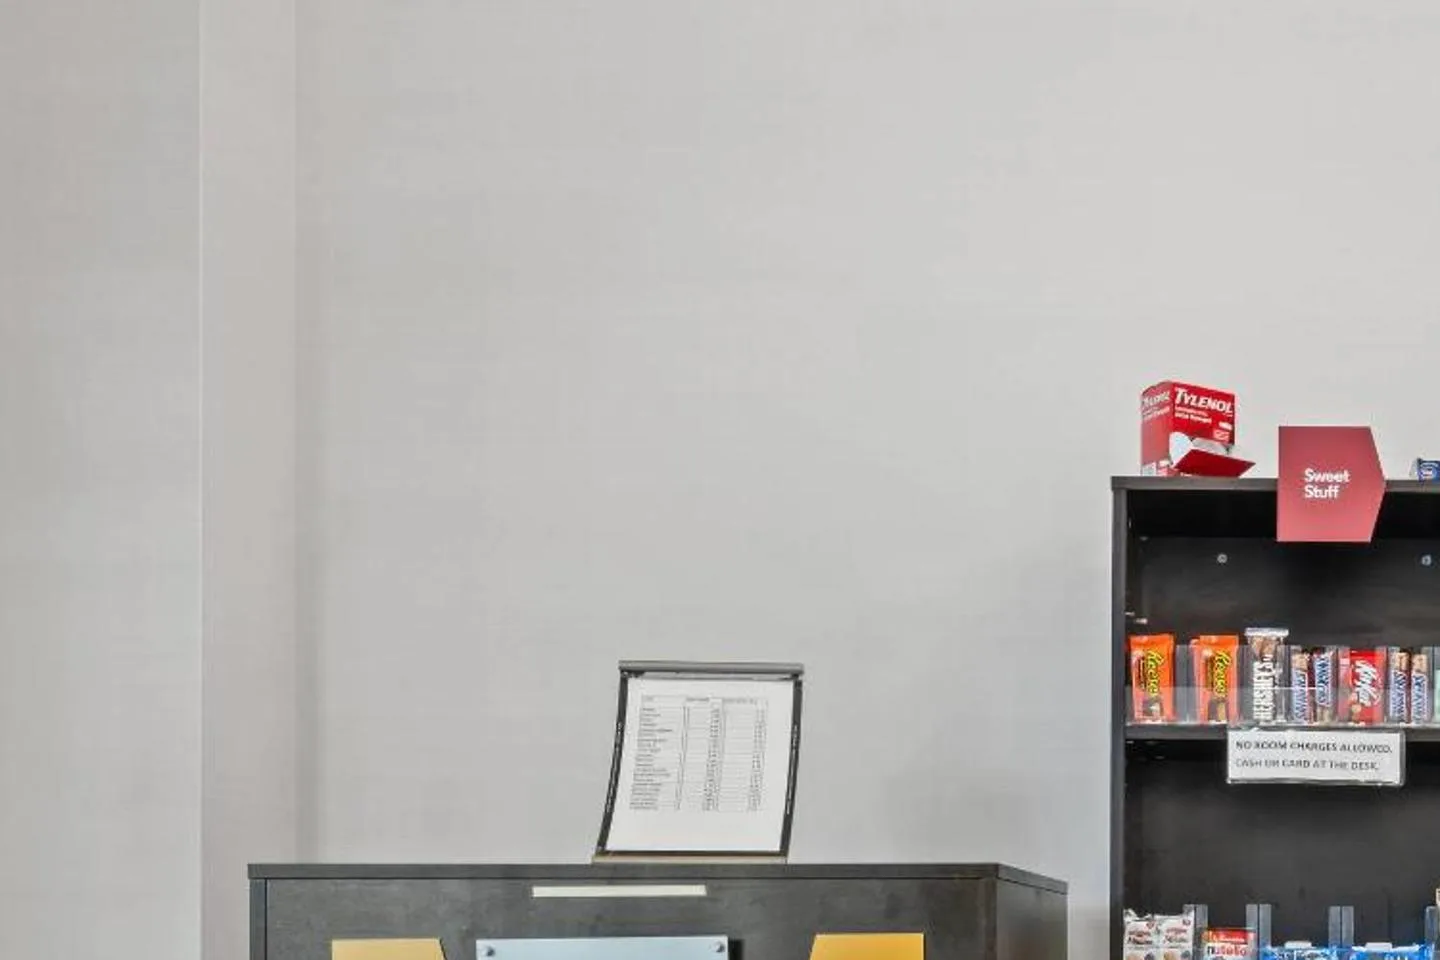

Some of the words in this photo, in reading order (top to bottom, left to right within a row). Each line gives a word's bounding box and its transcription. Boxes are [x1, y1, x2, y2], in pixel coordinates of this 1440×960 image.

[1174, 387, 1233, 414] TYLENOL
[1304, 467, 1351, 483] Sweet
[1304, 484, 1341, 499] Stuff
[1235, 741, 1251, 750] NO
[1254, 741, 1287, 750] ROOM
[1290, 741, 1337, 751] CHARGES
[1235, 758, 1262, 768] CASH
[1265, 759, 1280, 768] OR
[1282, 759, 1310, 769] CARD
[1313, 760, 1326, 769] AT
[1330, 760, 1348, 770] THE
